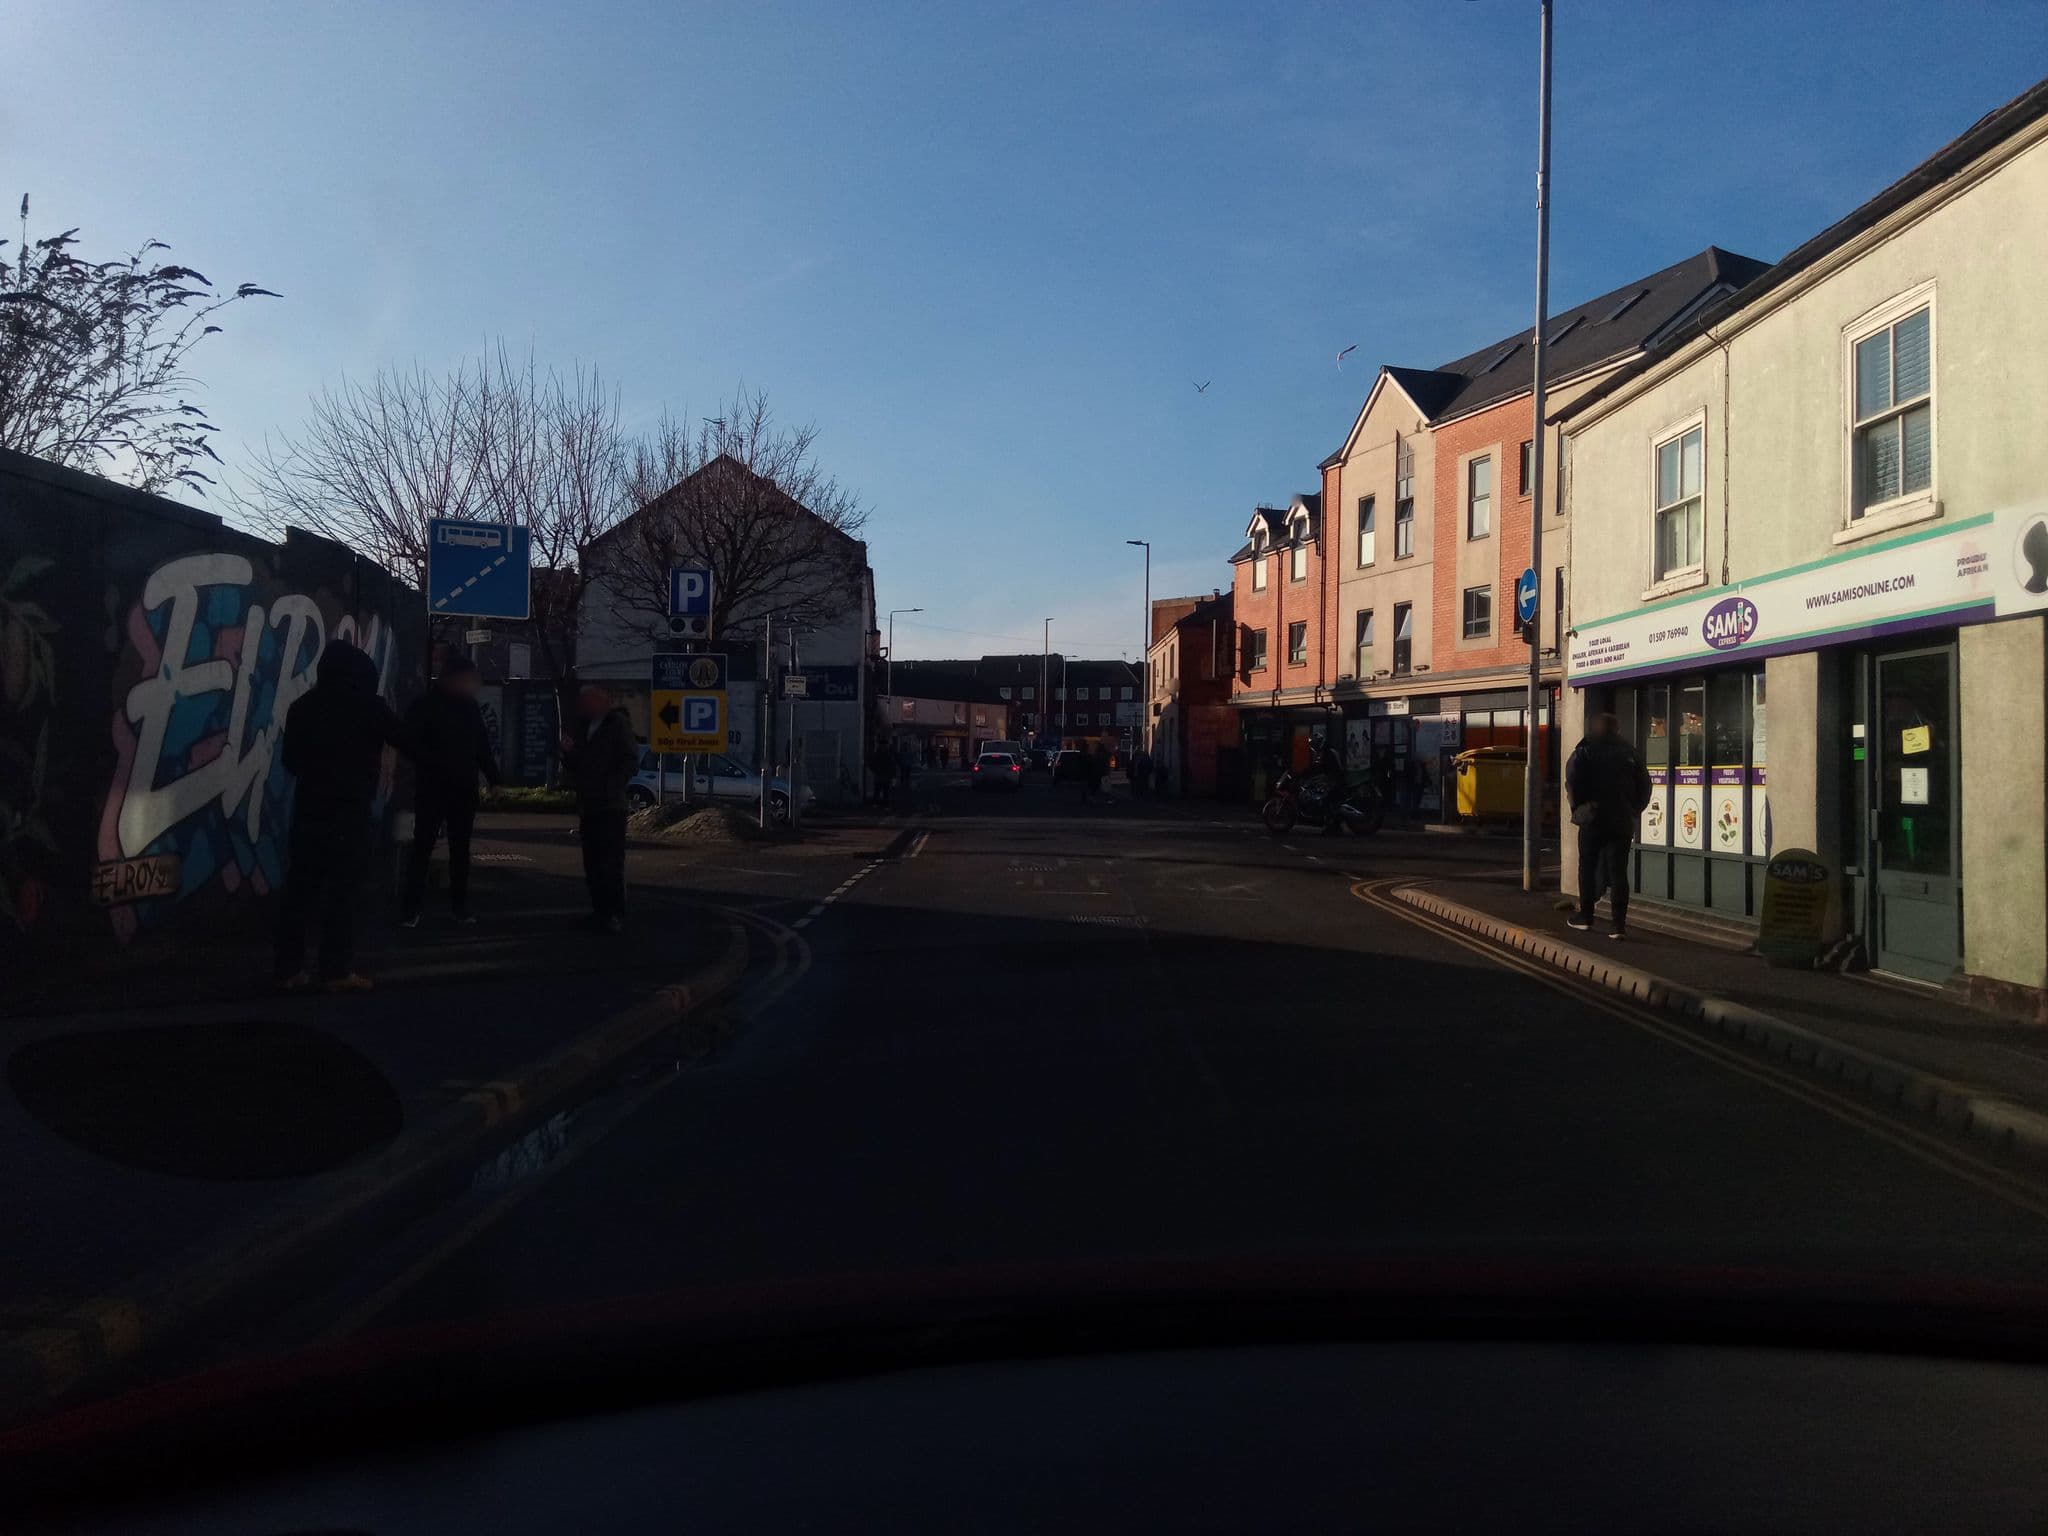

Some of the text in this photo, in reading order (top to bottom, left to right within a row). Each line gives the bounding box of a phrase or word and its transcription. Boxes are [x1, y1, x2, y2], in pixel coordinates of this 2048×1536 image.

[1956, 552, 1988, 567] PROUDLY
[677, 571, 705, 613] P
[1805, 574, 1915, 609] WWW.SAMISONLINE.COM
[1589, 636, 1612, 647] YOUR LOCAL
[1648, 626, 1689, 644] 01509 769940
[1613, 653, 1625, 662] MART
[690, 702, 713, 729] P
[92, 859, 158, 897] ELROY
